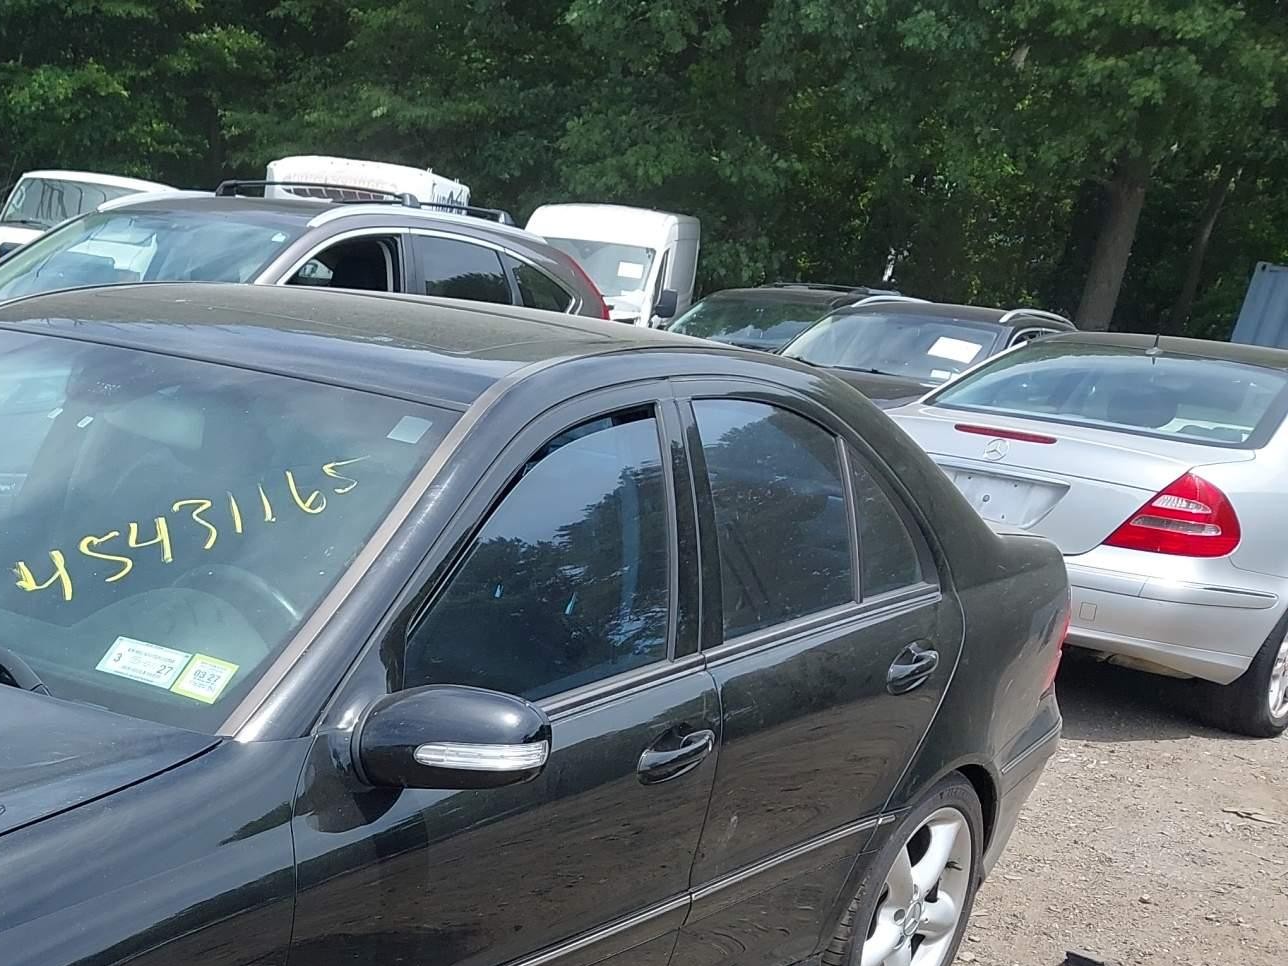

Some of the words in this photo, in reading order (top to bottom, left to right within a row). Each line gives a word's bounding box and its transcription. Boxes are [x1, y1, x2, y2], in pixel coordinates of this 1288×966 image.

[13, 455, 372, 601] 45431165
[113, 652, 123, 664] 3
[156, 664, 175, 677] 27
